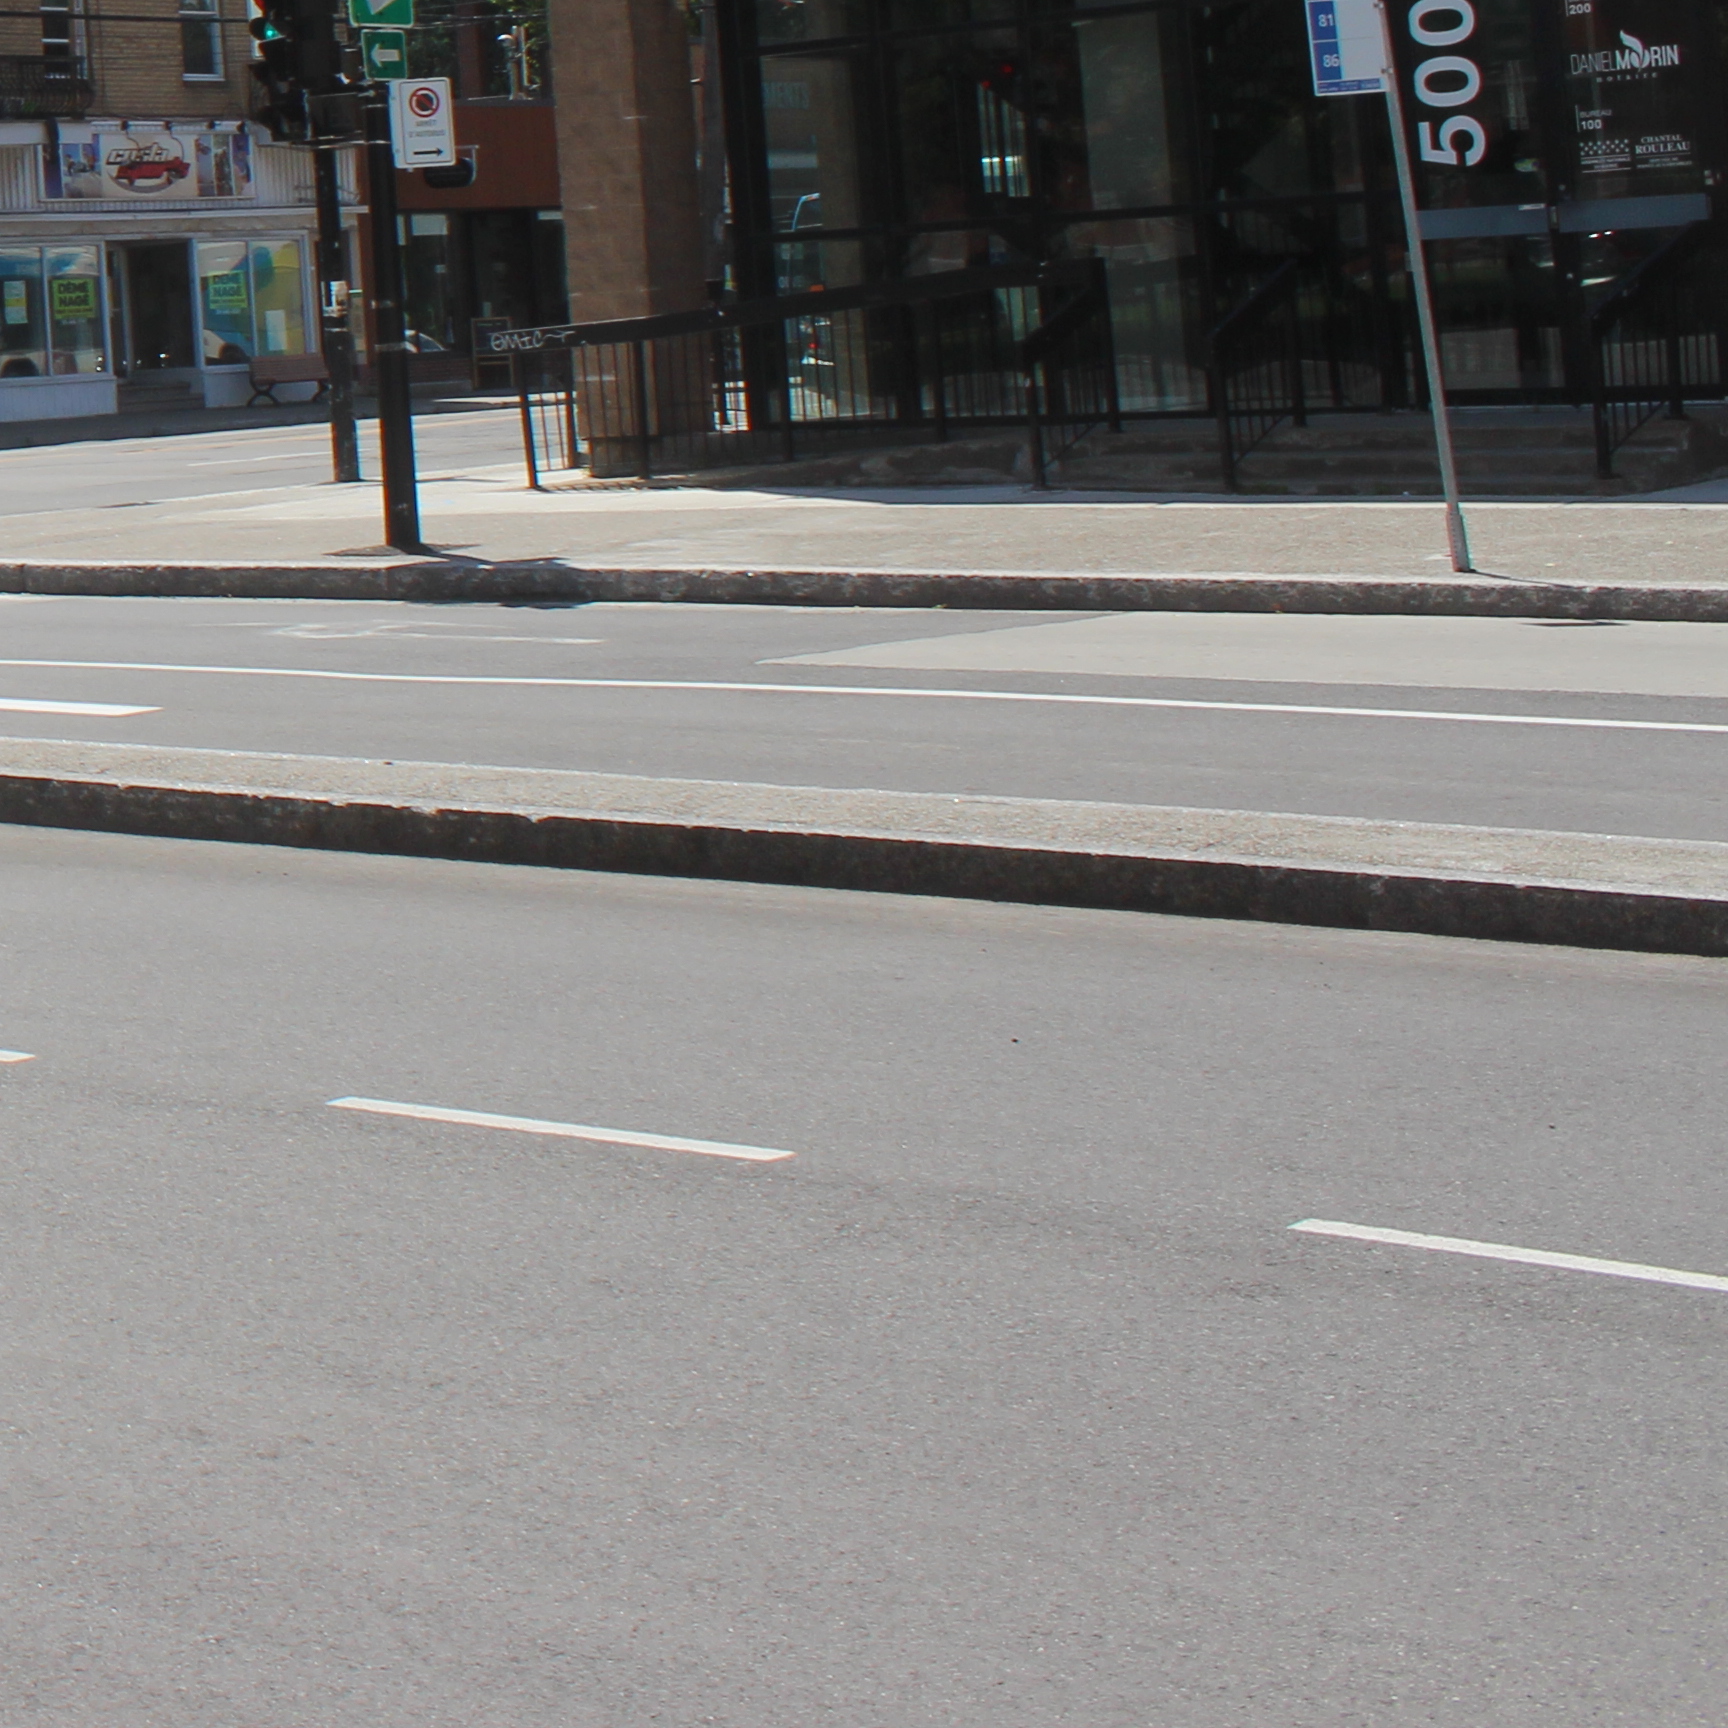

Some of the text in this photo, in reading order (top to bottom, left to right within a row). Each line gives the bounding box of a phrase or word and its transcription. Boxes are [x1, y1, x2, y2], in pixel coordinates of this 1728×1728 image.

[1569, 3, 1592, 14] 200
[1318, 14, 1335, 27] 81
[1323, 54, 1340, 67] 86
[1581, 119, 1602, 130] 100
[1641, 134, 1682, 144] CHANTAL
[1635, 141, 1691, 154] ROULEAU
